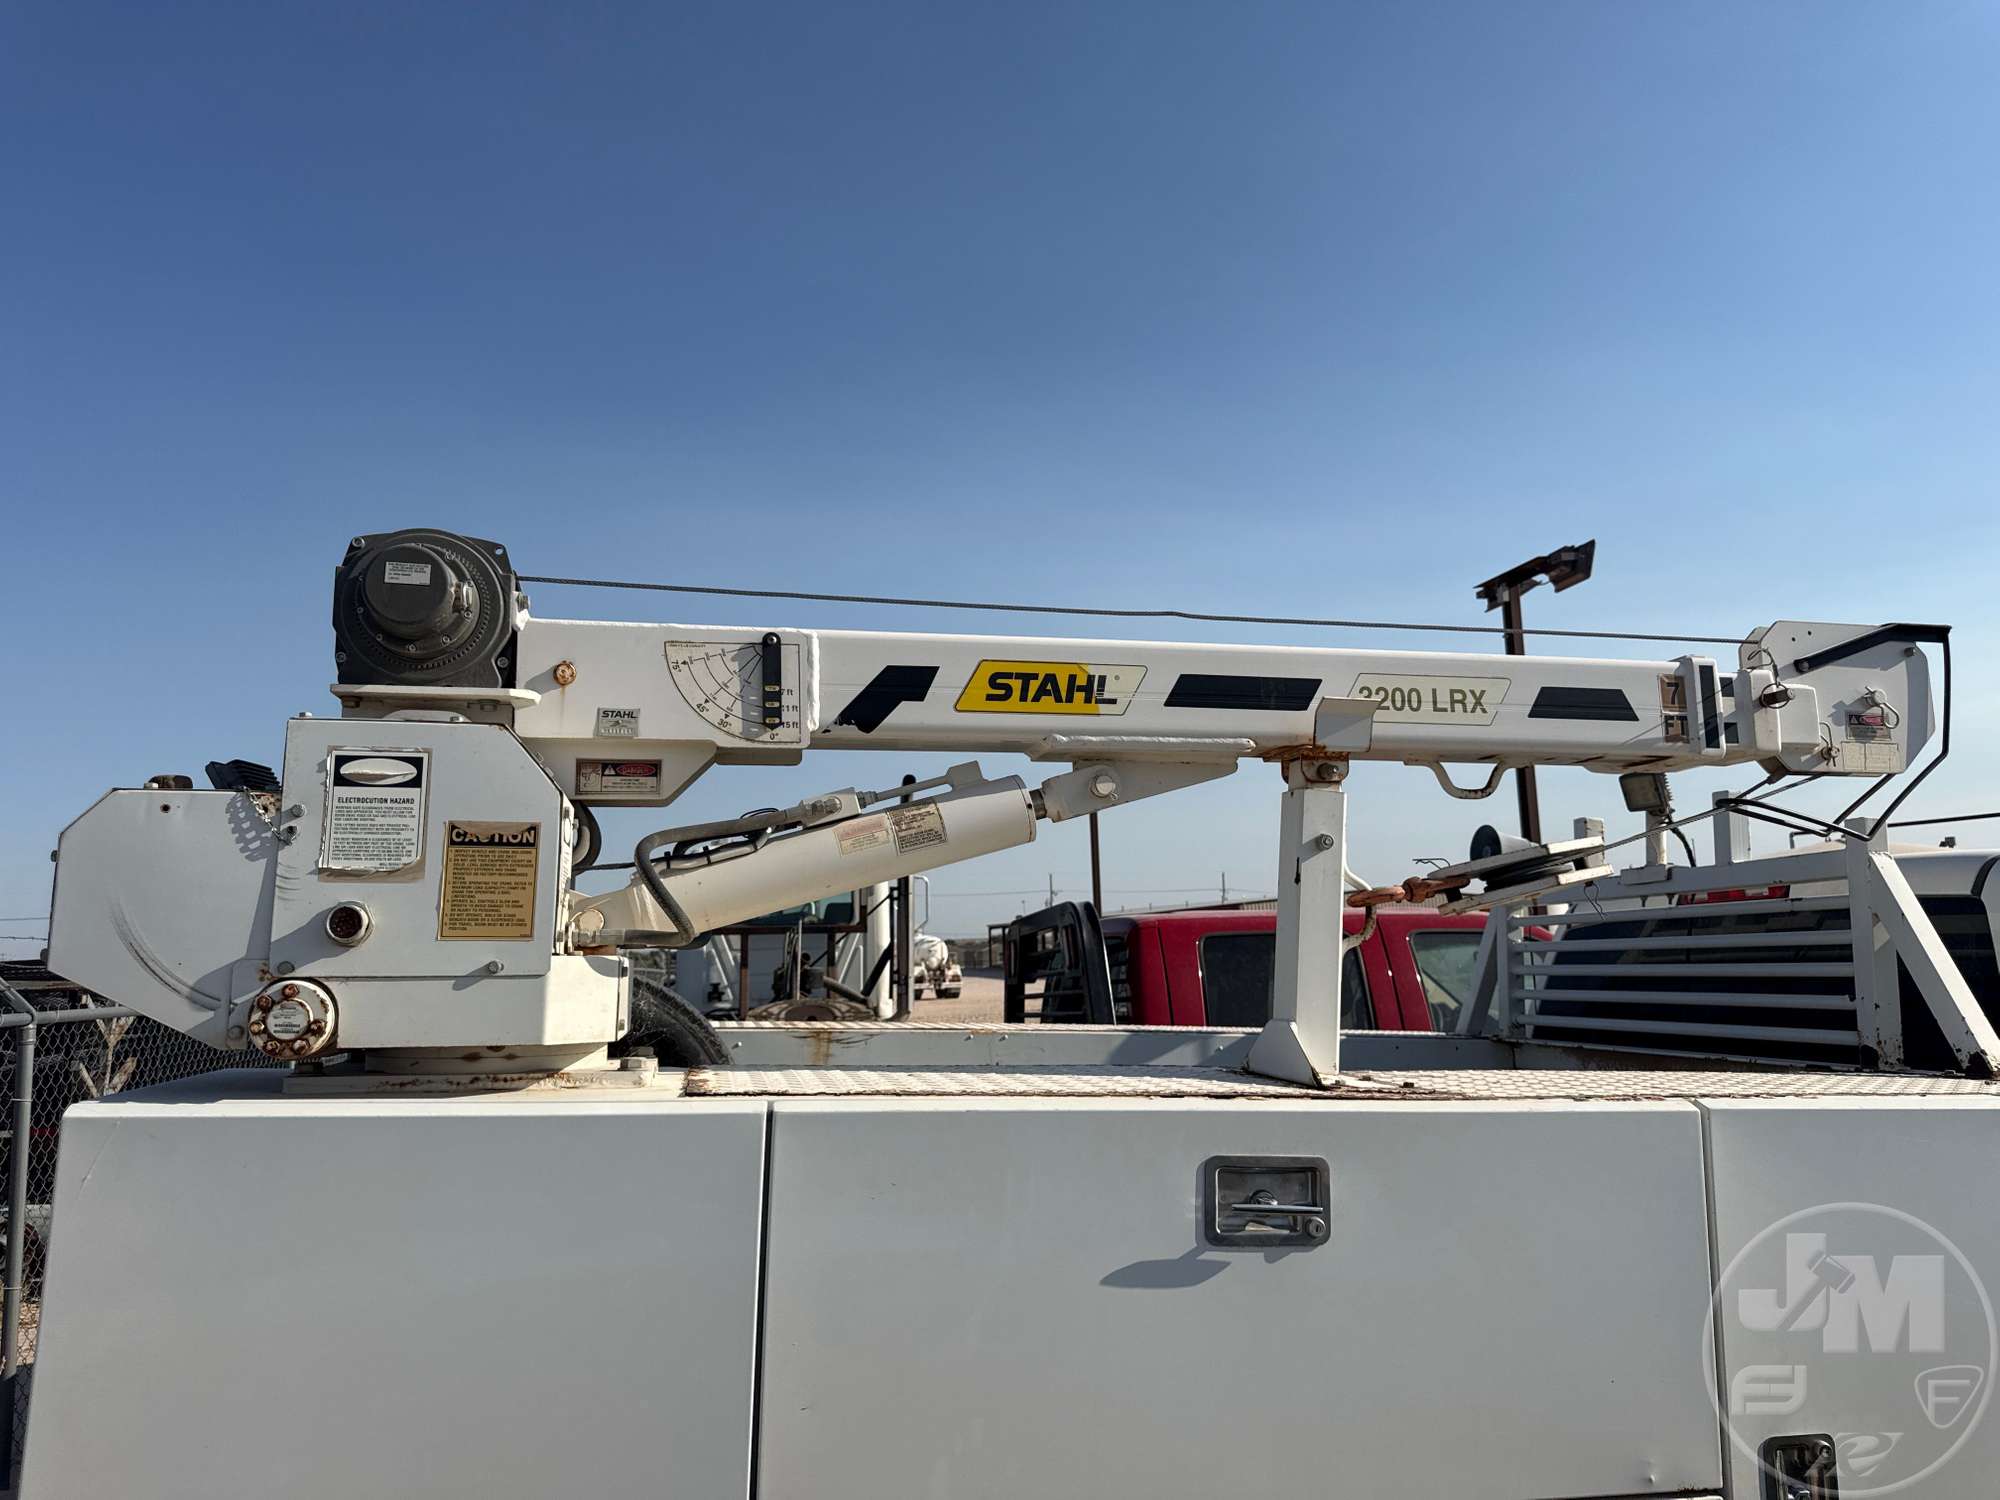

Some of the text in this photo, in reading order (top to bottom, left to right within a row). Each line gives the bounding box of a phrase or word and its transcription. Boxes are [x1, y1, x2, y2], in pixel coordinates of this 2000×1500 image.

[985, 671, 1118, 705] STAHL
[1666, 682, 1680, 704] 7
[1432, 688, 1488, 714] LRX
[601, 710, 639, 718] STAHL
[337, 796, 415, 805] ELECTROCUTION HAZARD
